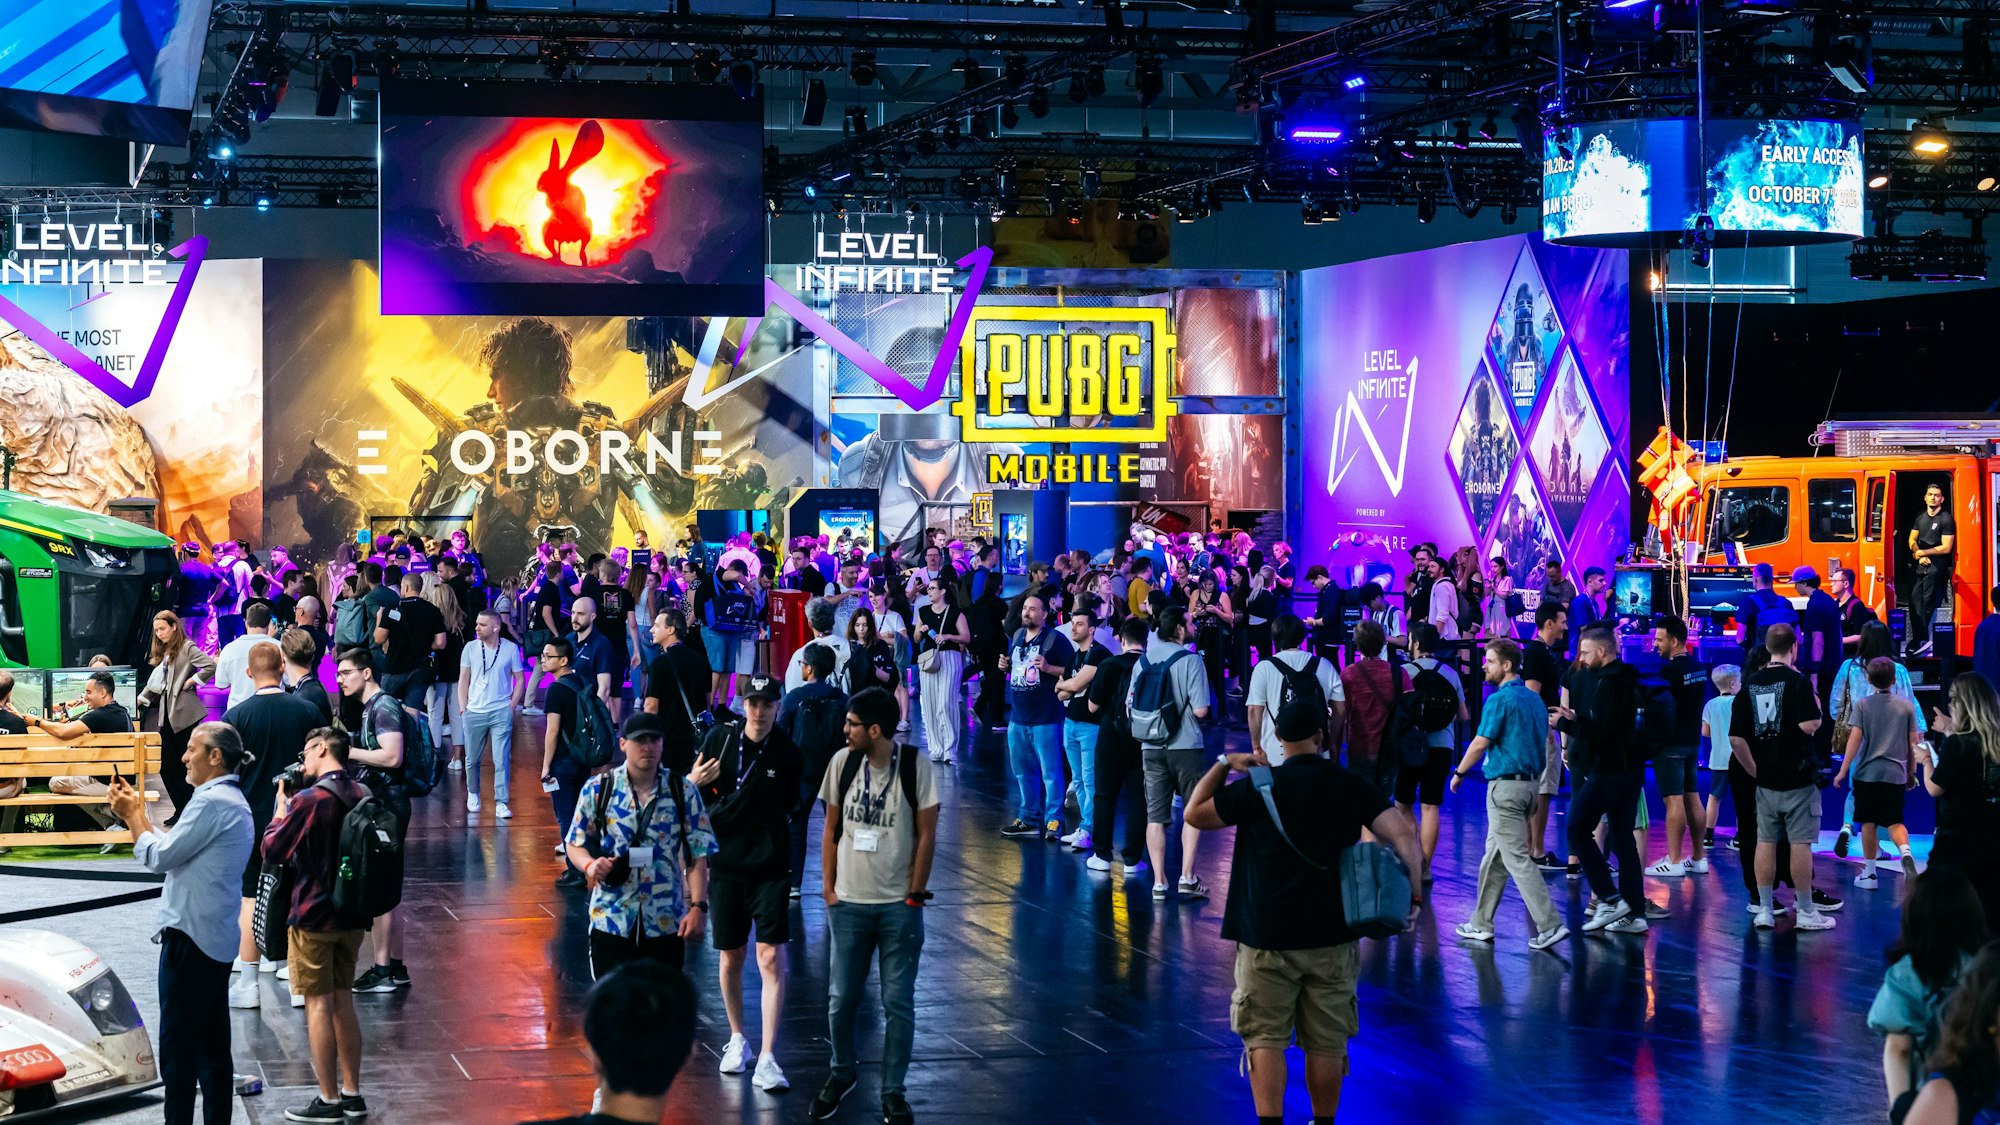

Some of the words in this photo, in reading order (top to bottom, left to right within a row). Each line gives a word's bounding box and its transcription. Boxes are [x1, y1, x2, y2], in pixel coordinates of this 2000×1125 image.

[1762, 145, 1809, 163] EARLY
[1812, 147, 1853, 166] ACCESS
[1748, 185, 1821, 204] OCTOBER
[16, 223, 149, 251] LEVEL
[817, 231, 938, 260] LEVEL
[2, 258, 167, 286] NFINITE
[796, 265, 954, 293] INFINITE
[75, 329, 122, 346] MOST
[1364, 349, 1402, 372] LEVEL
[986, 333, 1142, 417] PUBG
[1358, 376, 1407, 400] INFINITE
[987, 454, 1141, 484] MOBILE
[1465, 481, 1500, 494] EXOBORNE
[1551, 494, 1587, 504] AWAKENING
[1356, 508, 1379, 517] POWERED
[1380, 509, 1385, 517] BY
[49, 542, 75, 556] 9RX
[1865, 565, 1876, 606] 7
